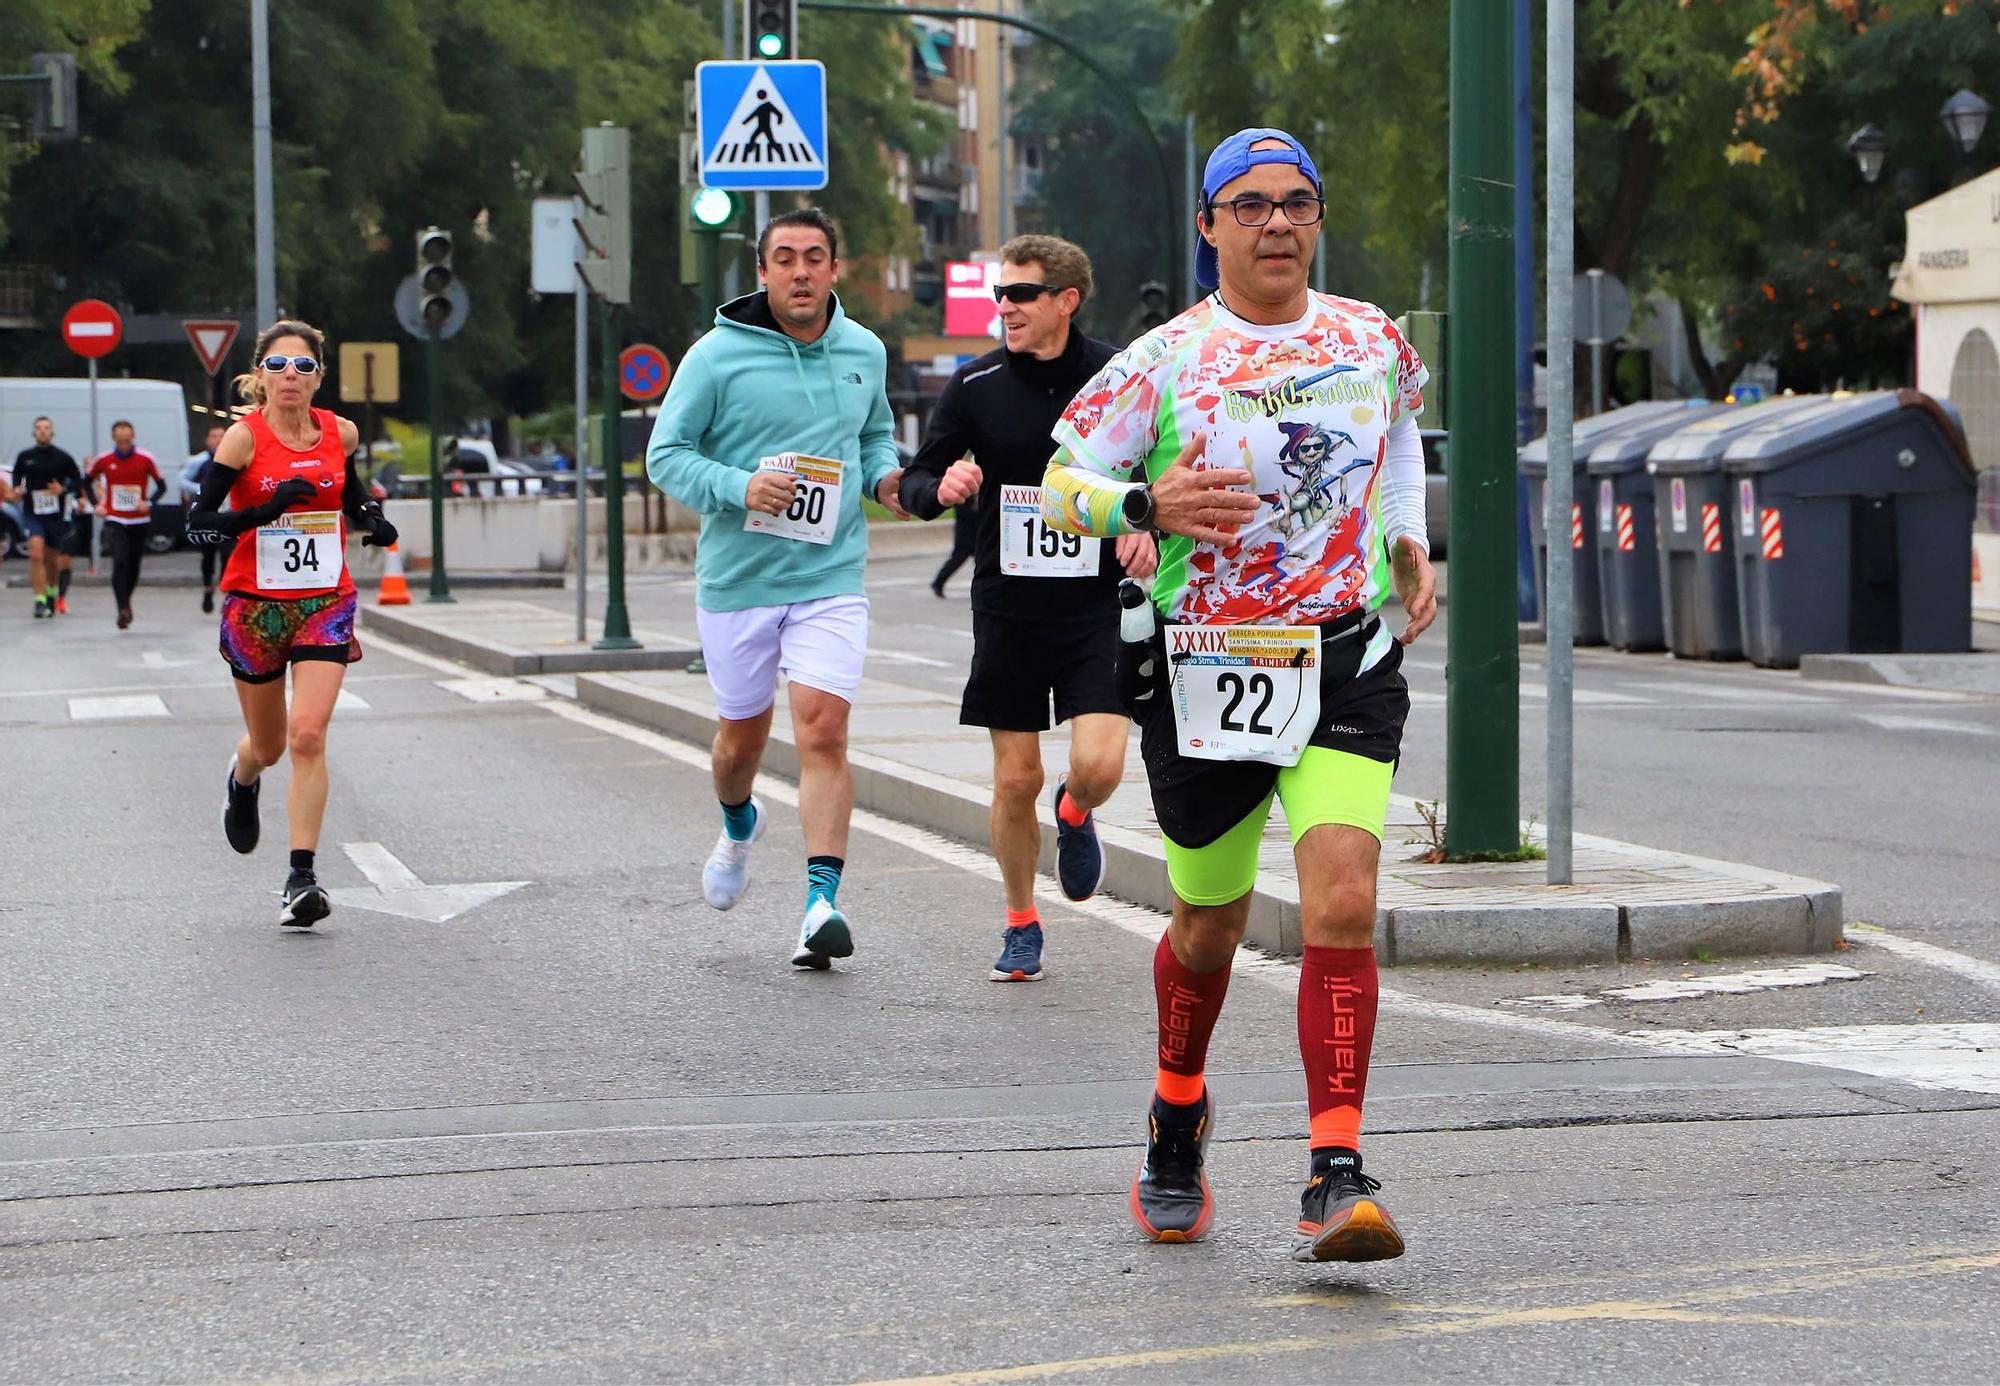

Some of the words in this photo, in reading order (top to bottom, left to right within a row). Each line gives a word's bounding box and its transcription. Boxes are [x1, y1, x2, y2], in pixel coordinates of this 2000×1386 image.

[772, 484, 825, 525] 60
[1005, 490, 1039, 504] XXXIX
[284, 538, 319, 572] 34
[1172, 631, 1227, 652] XXXIX
[1198, 656, 1217, 665] Stma.
[1218, 656, 1246, 665] Trinidad
[1253, 658, 1314, 667] TRINITAOS
[1217, 672, 1274, 736] 22
[1330, 1156, 1354, 1167] HOKA
